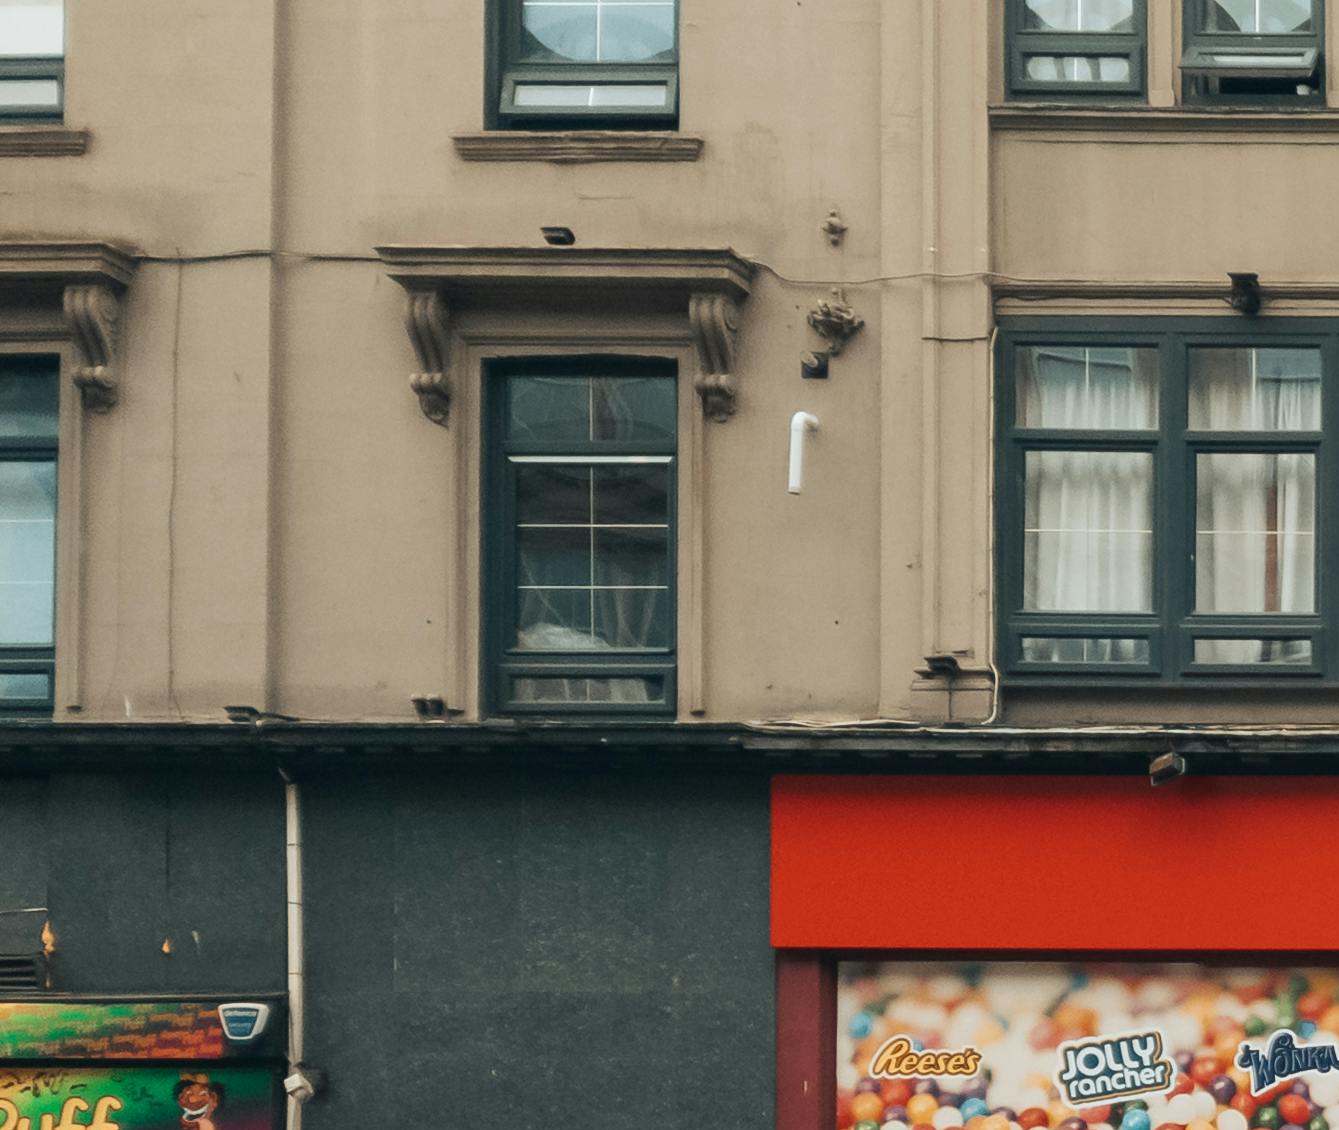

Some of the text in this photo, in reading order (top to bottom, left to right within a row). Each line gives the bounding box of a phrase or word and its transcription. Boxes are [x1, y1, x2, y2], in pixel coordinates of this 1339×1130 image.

[873, 1037, 982, 1077] Reese's
[1061, 1036, 1160, 1081] JOLLY
[1068, 1064, 1168, 1099] rancher
